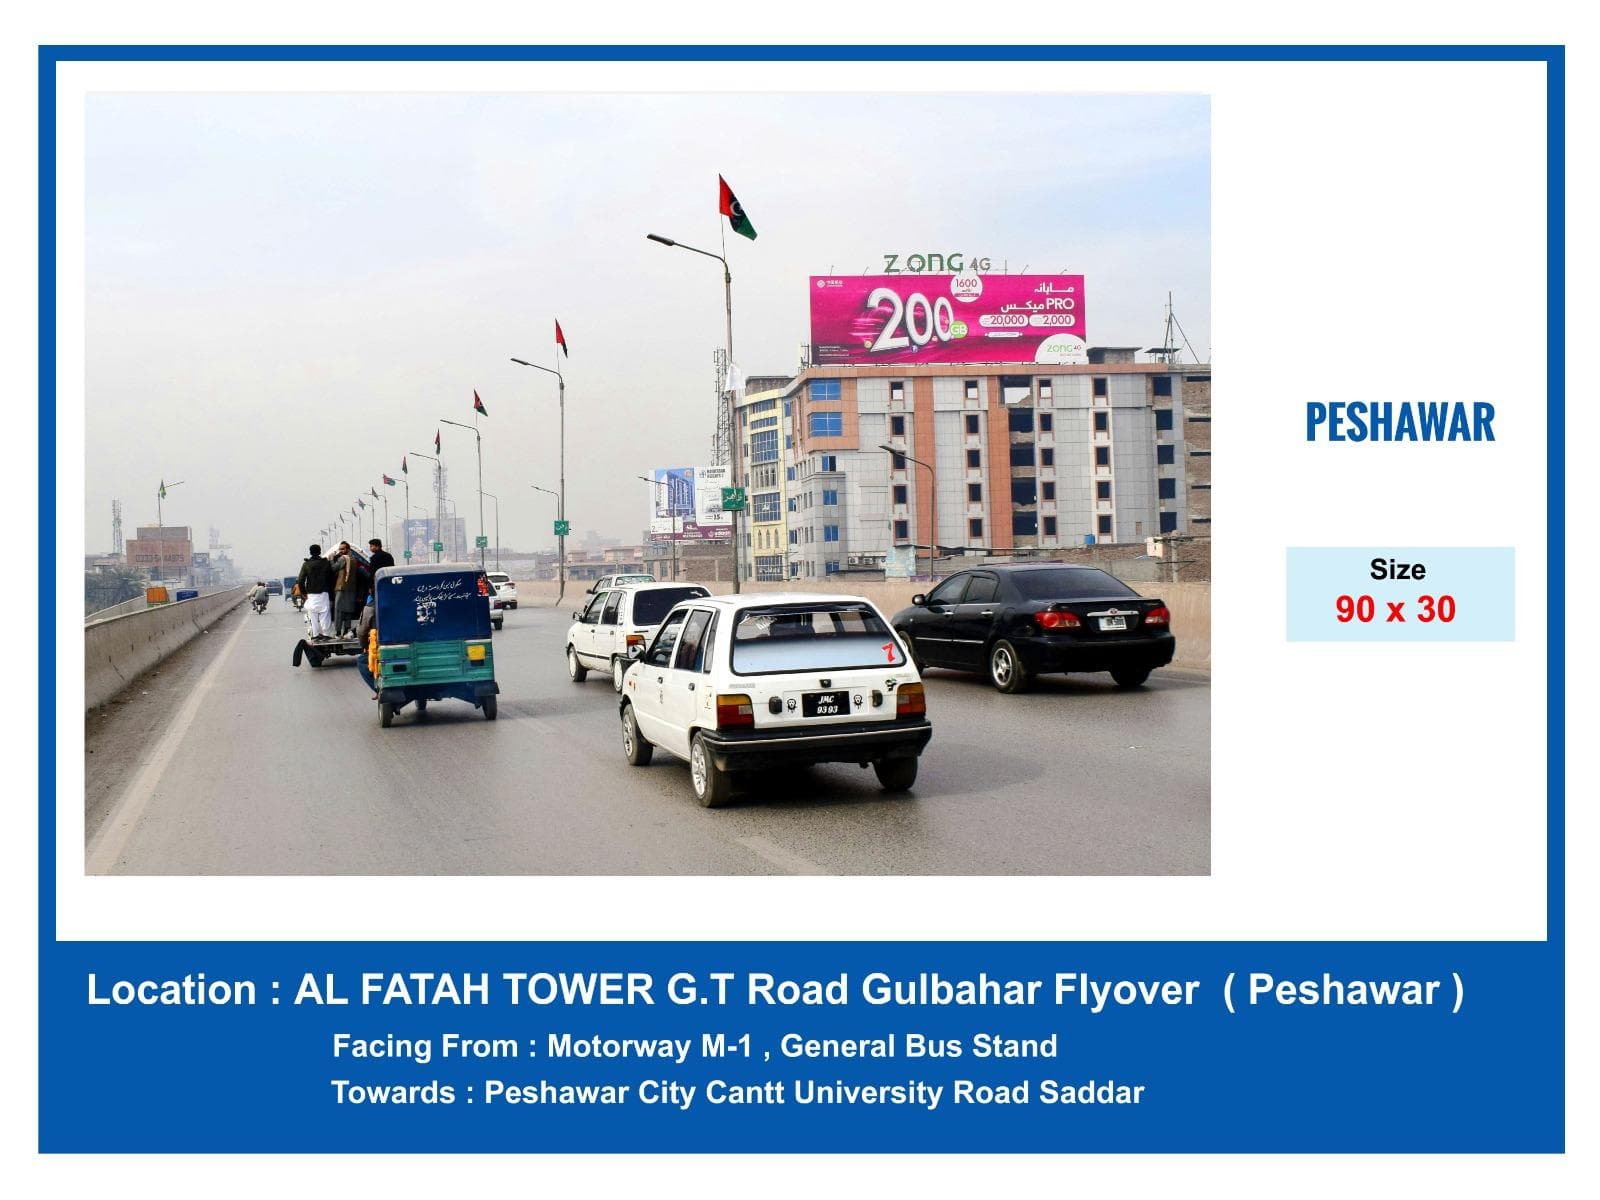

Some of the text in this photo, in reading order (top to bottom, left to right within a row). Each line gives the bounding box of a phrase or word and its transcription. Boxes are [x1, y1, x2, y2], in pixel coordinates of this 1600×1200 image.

[956, 278, 978, 288] 1600
[1046, 298, 1075, 310] PRO
[867, 287, 967, 353] 200 GB
[990, 315, 1025, 326] 20,000
[1043, 315, 1072, 326] 2,000
[881, 641, 896, 663] 7
